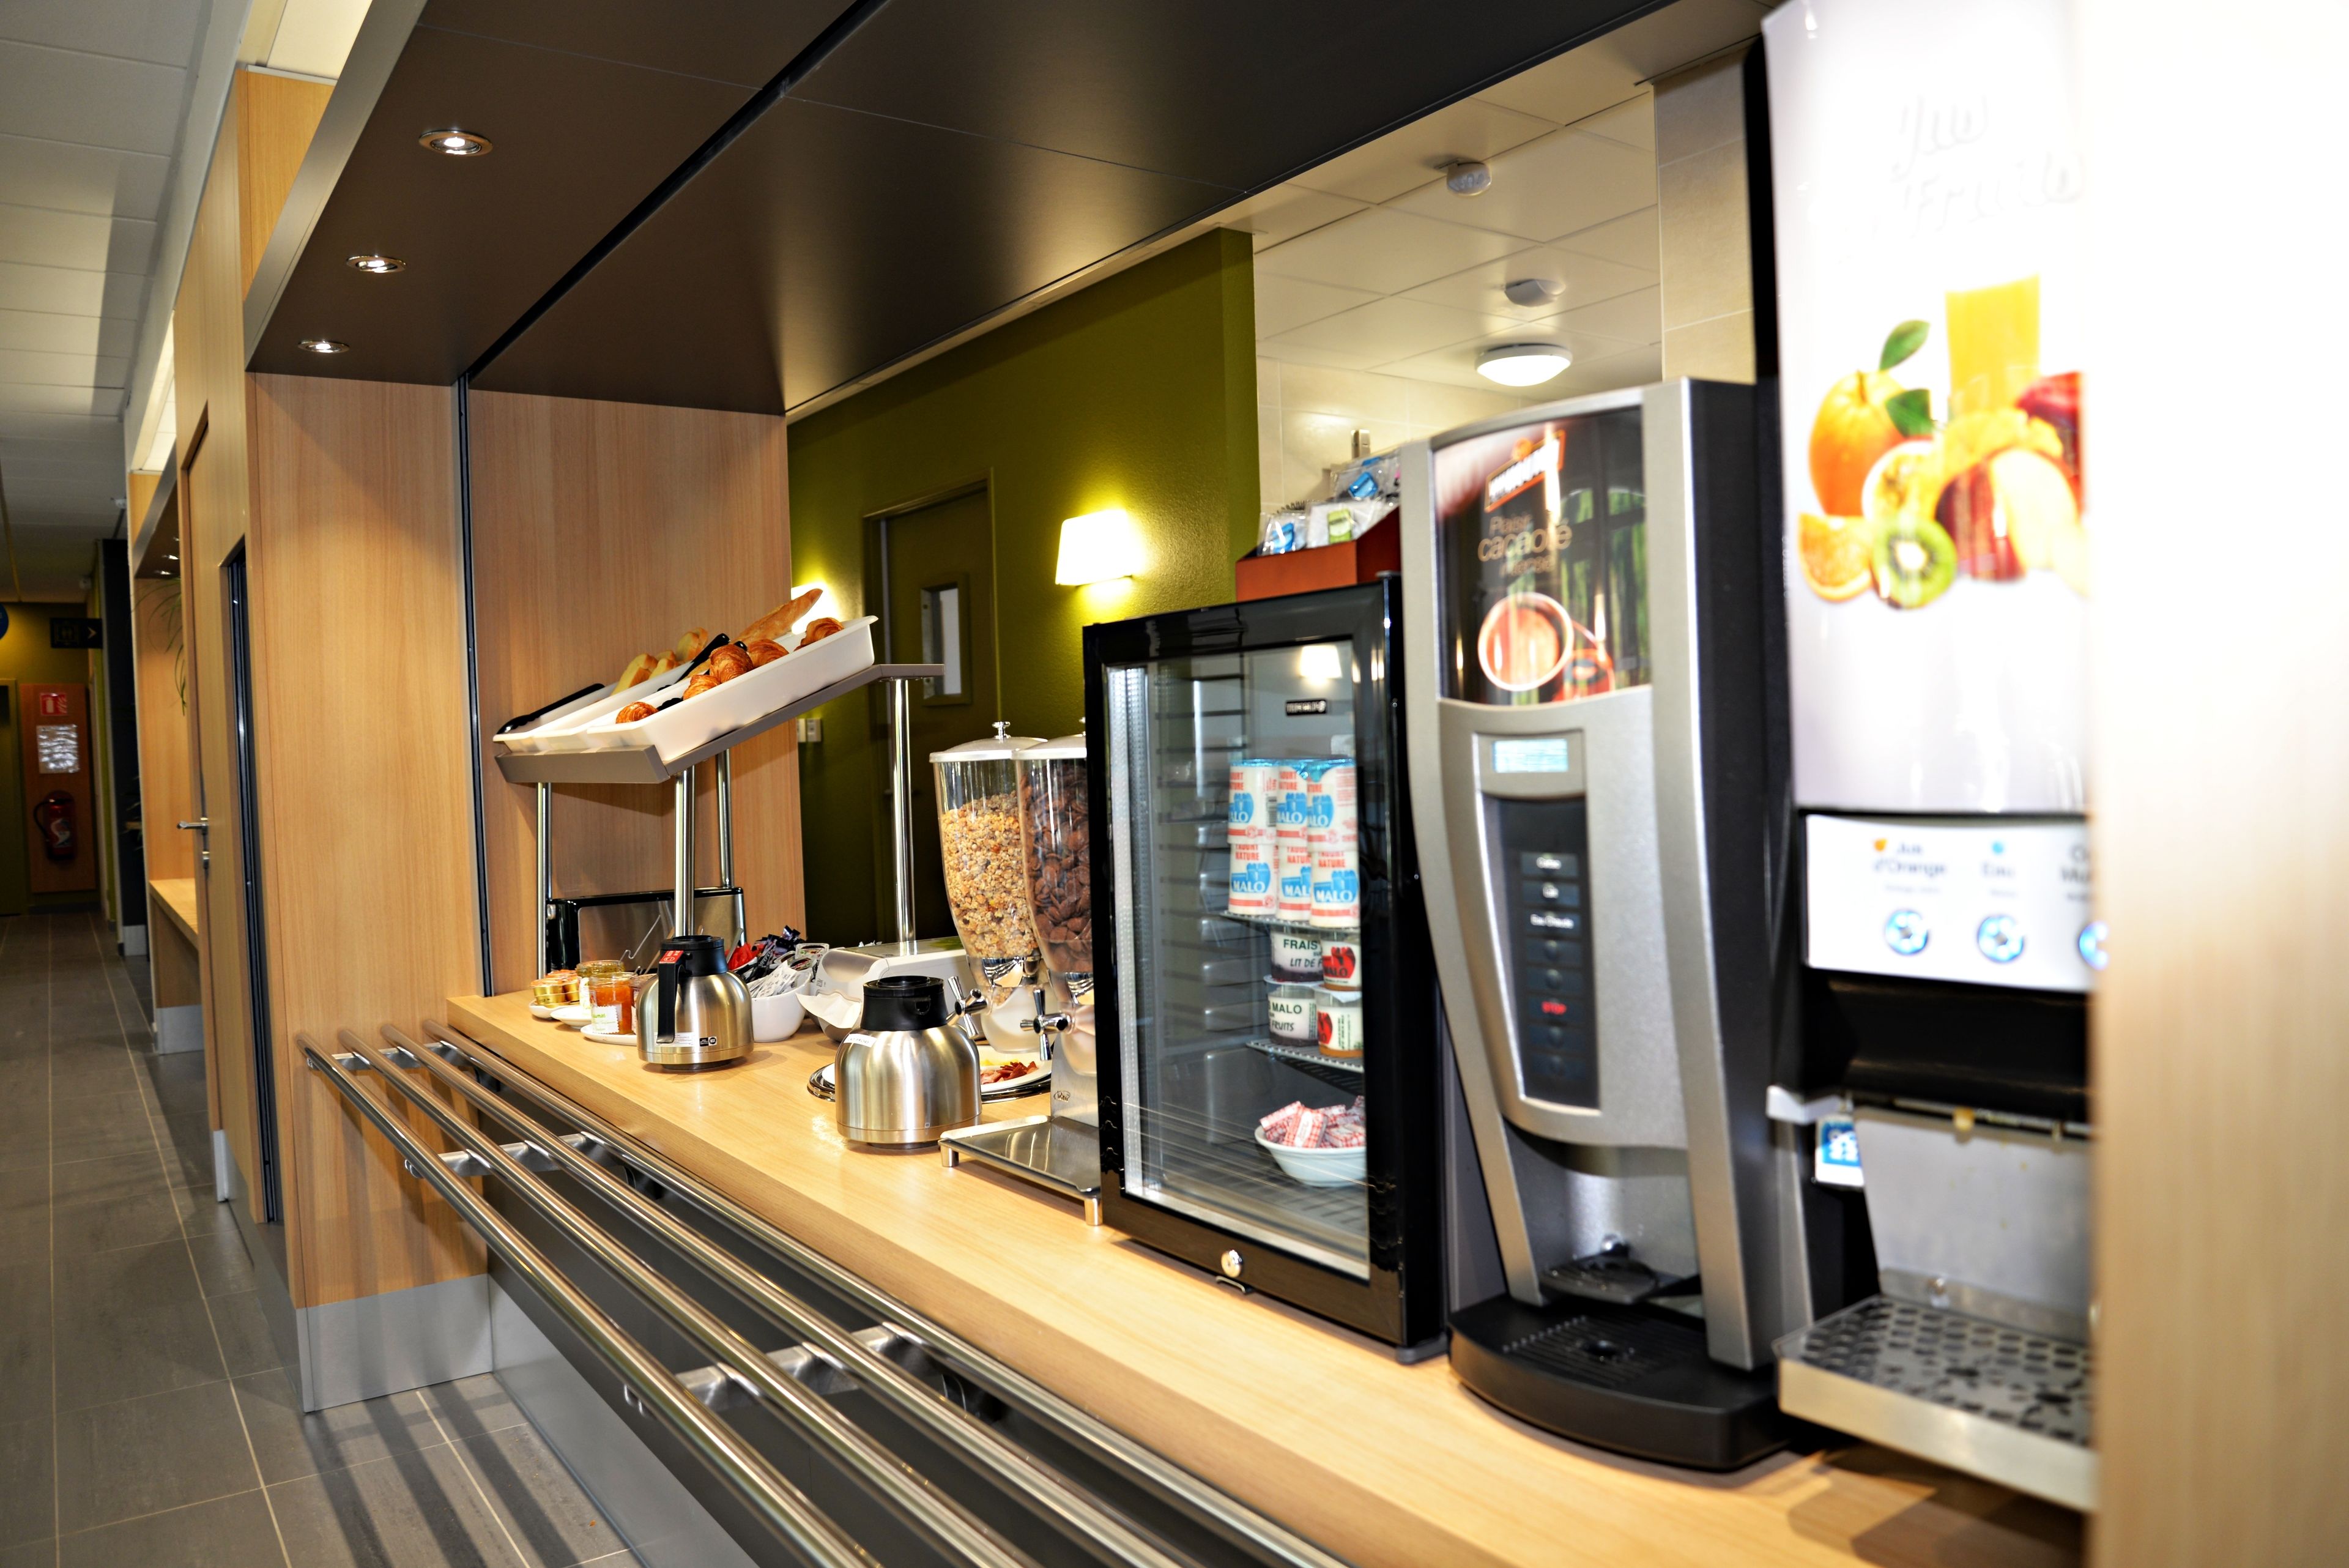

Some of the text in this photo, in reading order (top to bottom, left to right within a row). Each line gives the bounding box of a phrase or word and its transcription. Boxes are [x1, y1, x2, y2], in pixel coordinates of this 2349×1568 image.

[1478, 518, 1573, 562] cacaoé
[1287, 855, 1312, 864] NATUR
[1233, 880, 1266, 893] MALO
[1285, 885, 1310, 897] MAL
[1316, 890, 1353, 902] MALO
[1283, 938, 1318, 950] FRAIS
[1290, 958, 1302, 967] LIT
[1304, 958, 1315, 968] DE
[1272, 1001, 1302, 1015] MALO
[1272, 1020, 1295, 1032] FRUITS
